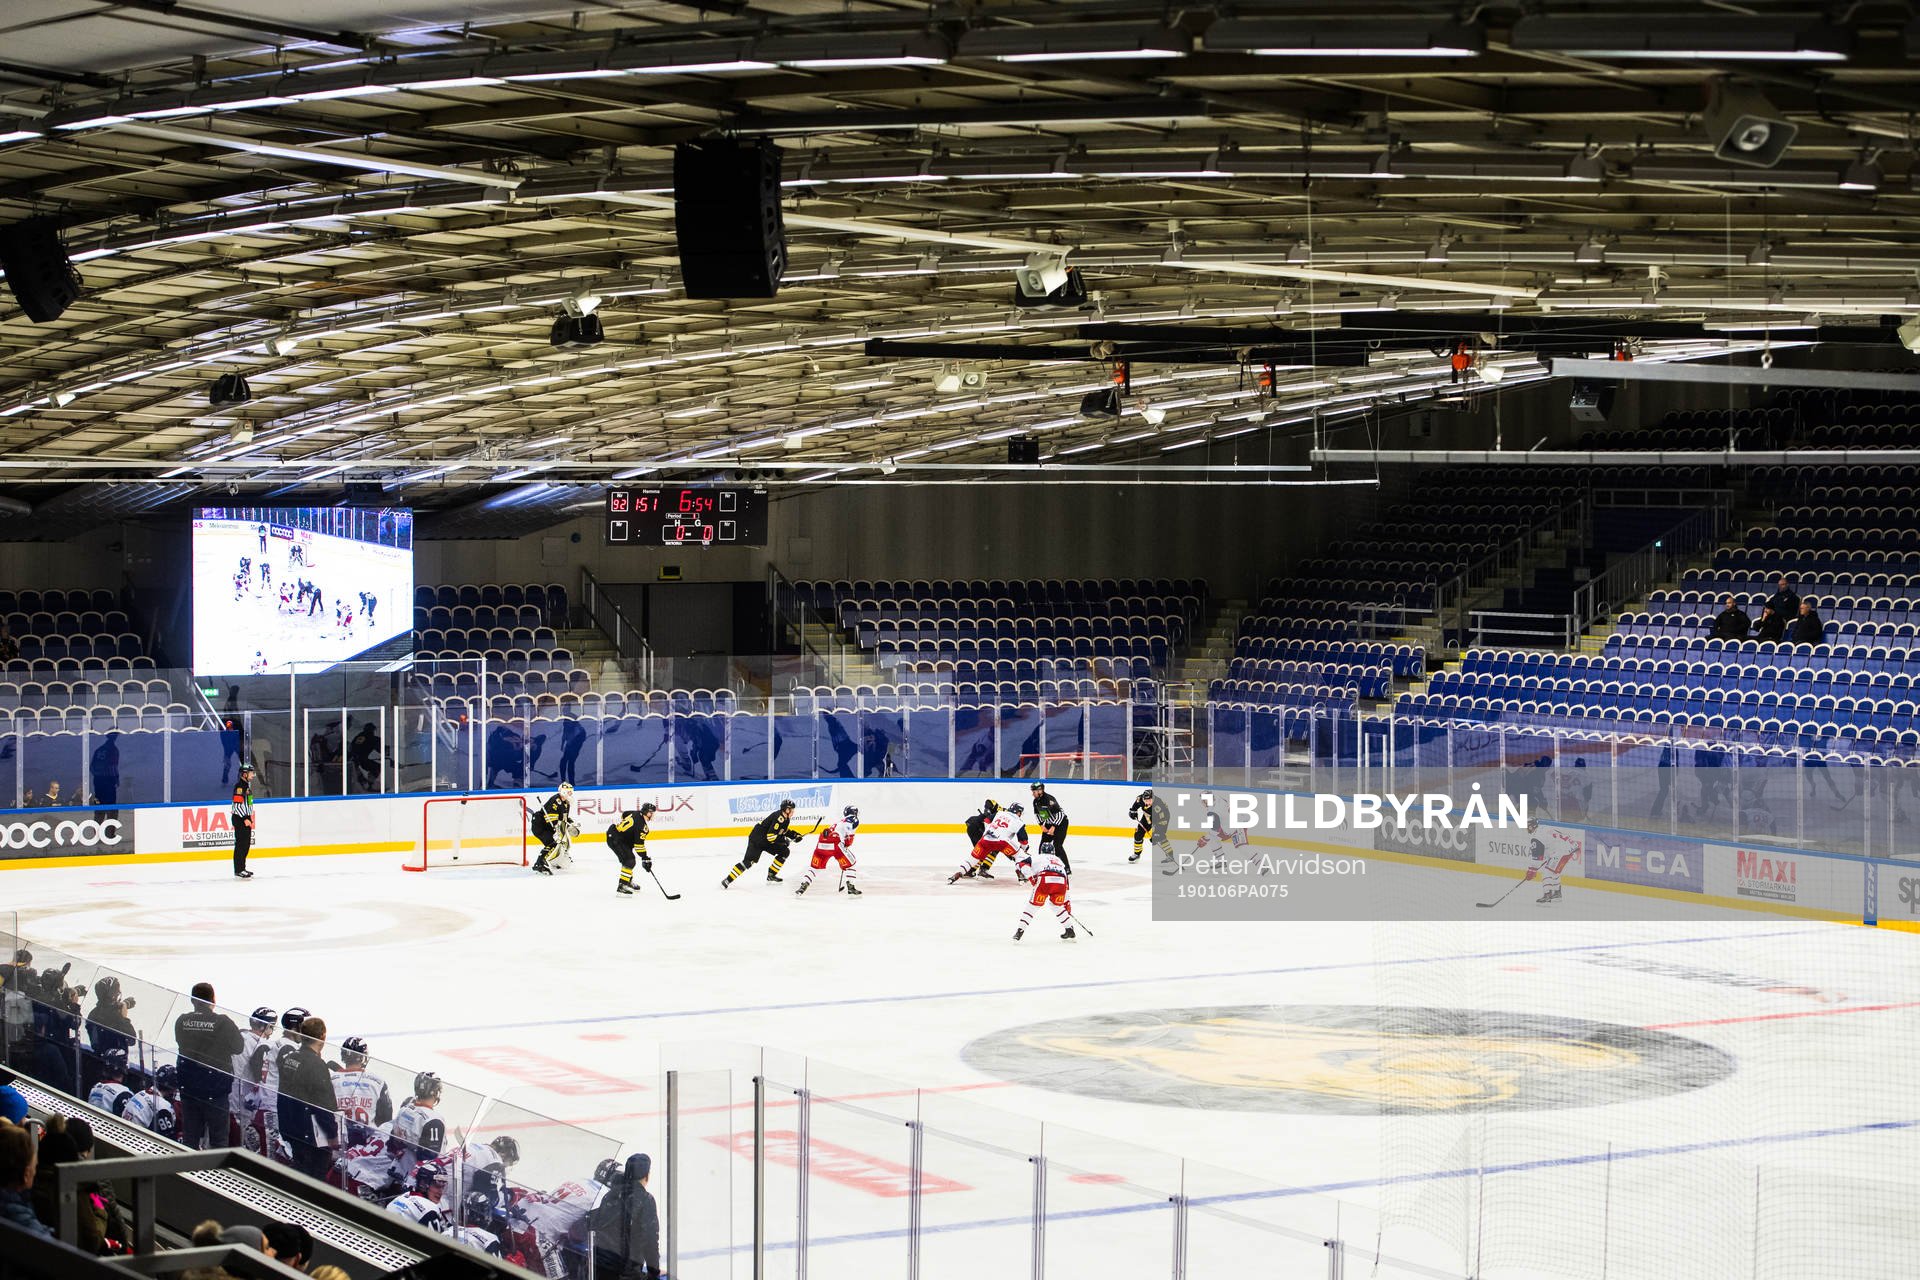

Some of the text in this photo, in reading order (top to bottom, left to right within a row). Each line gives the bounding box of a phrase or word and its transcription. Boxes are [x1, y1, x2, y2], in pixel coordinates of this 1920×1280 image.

[613, 498, 627, 510] 92
[679, 490, 713, 512] 6:54
[694, 519, 701, 527] G
[676, 525, 712, 540] 0 0
[183, 808, 255, 832] MAI
[733, 815, 766, 823] Profilkläd
[196, 831, 255, 841] STORMARD
[1597, 843, 1691, 878] MECA
[1737, 850, 1797, 884] MAXI
[1747, 880, 1796, 893] STORMARKNAD
[1867, 863, 1875, 915] CCM
[183, 1019, 215, 1029] VÄSTERVIK
[430, 1127, 439, 1142] 11
